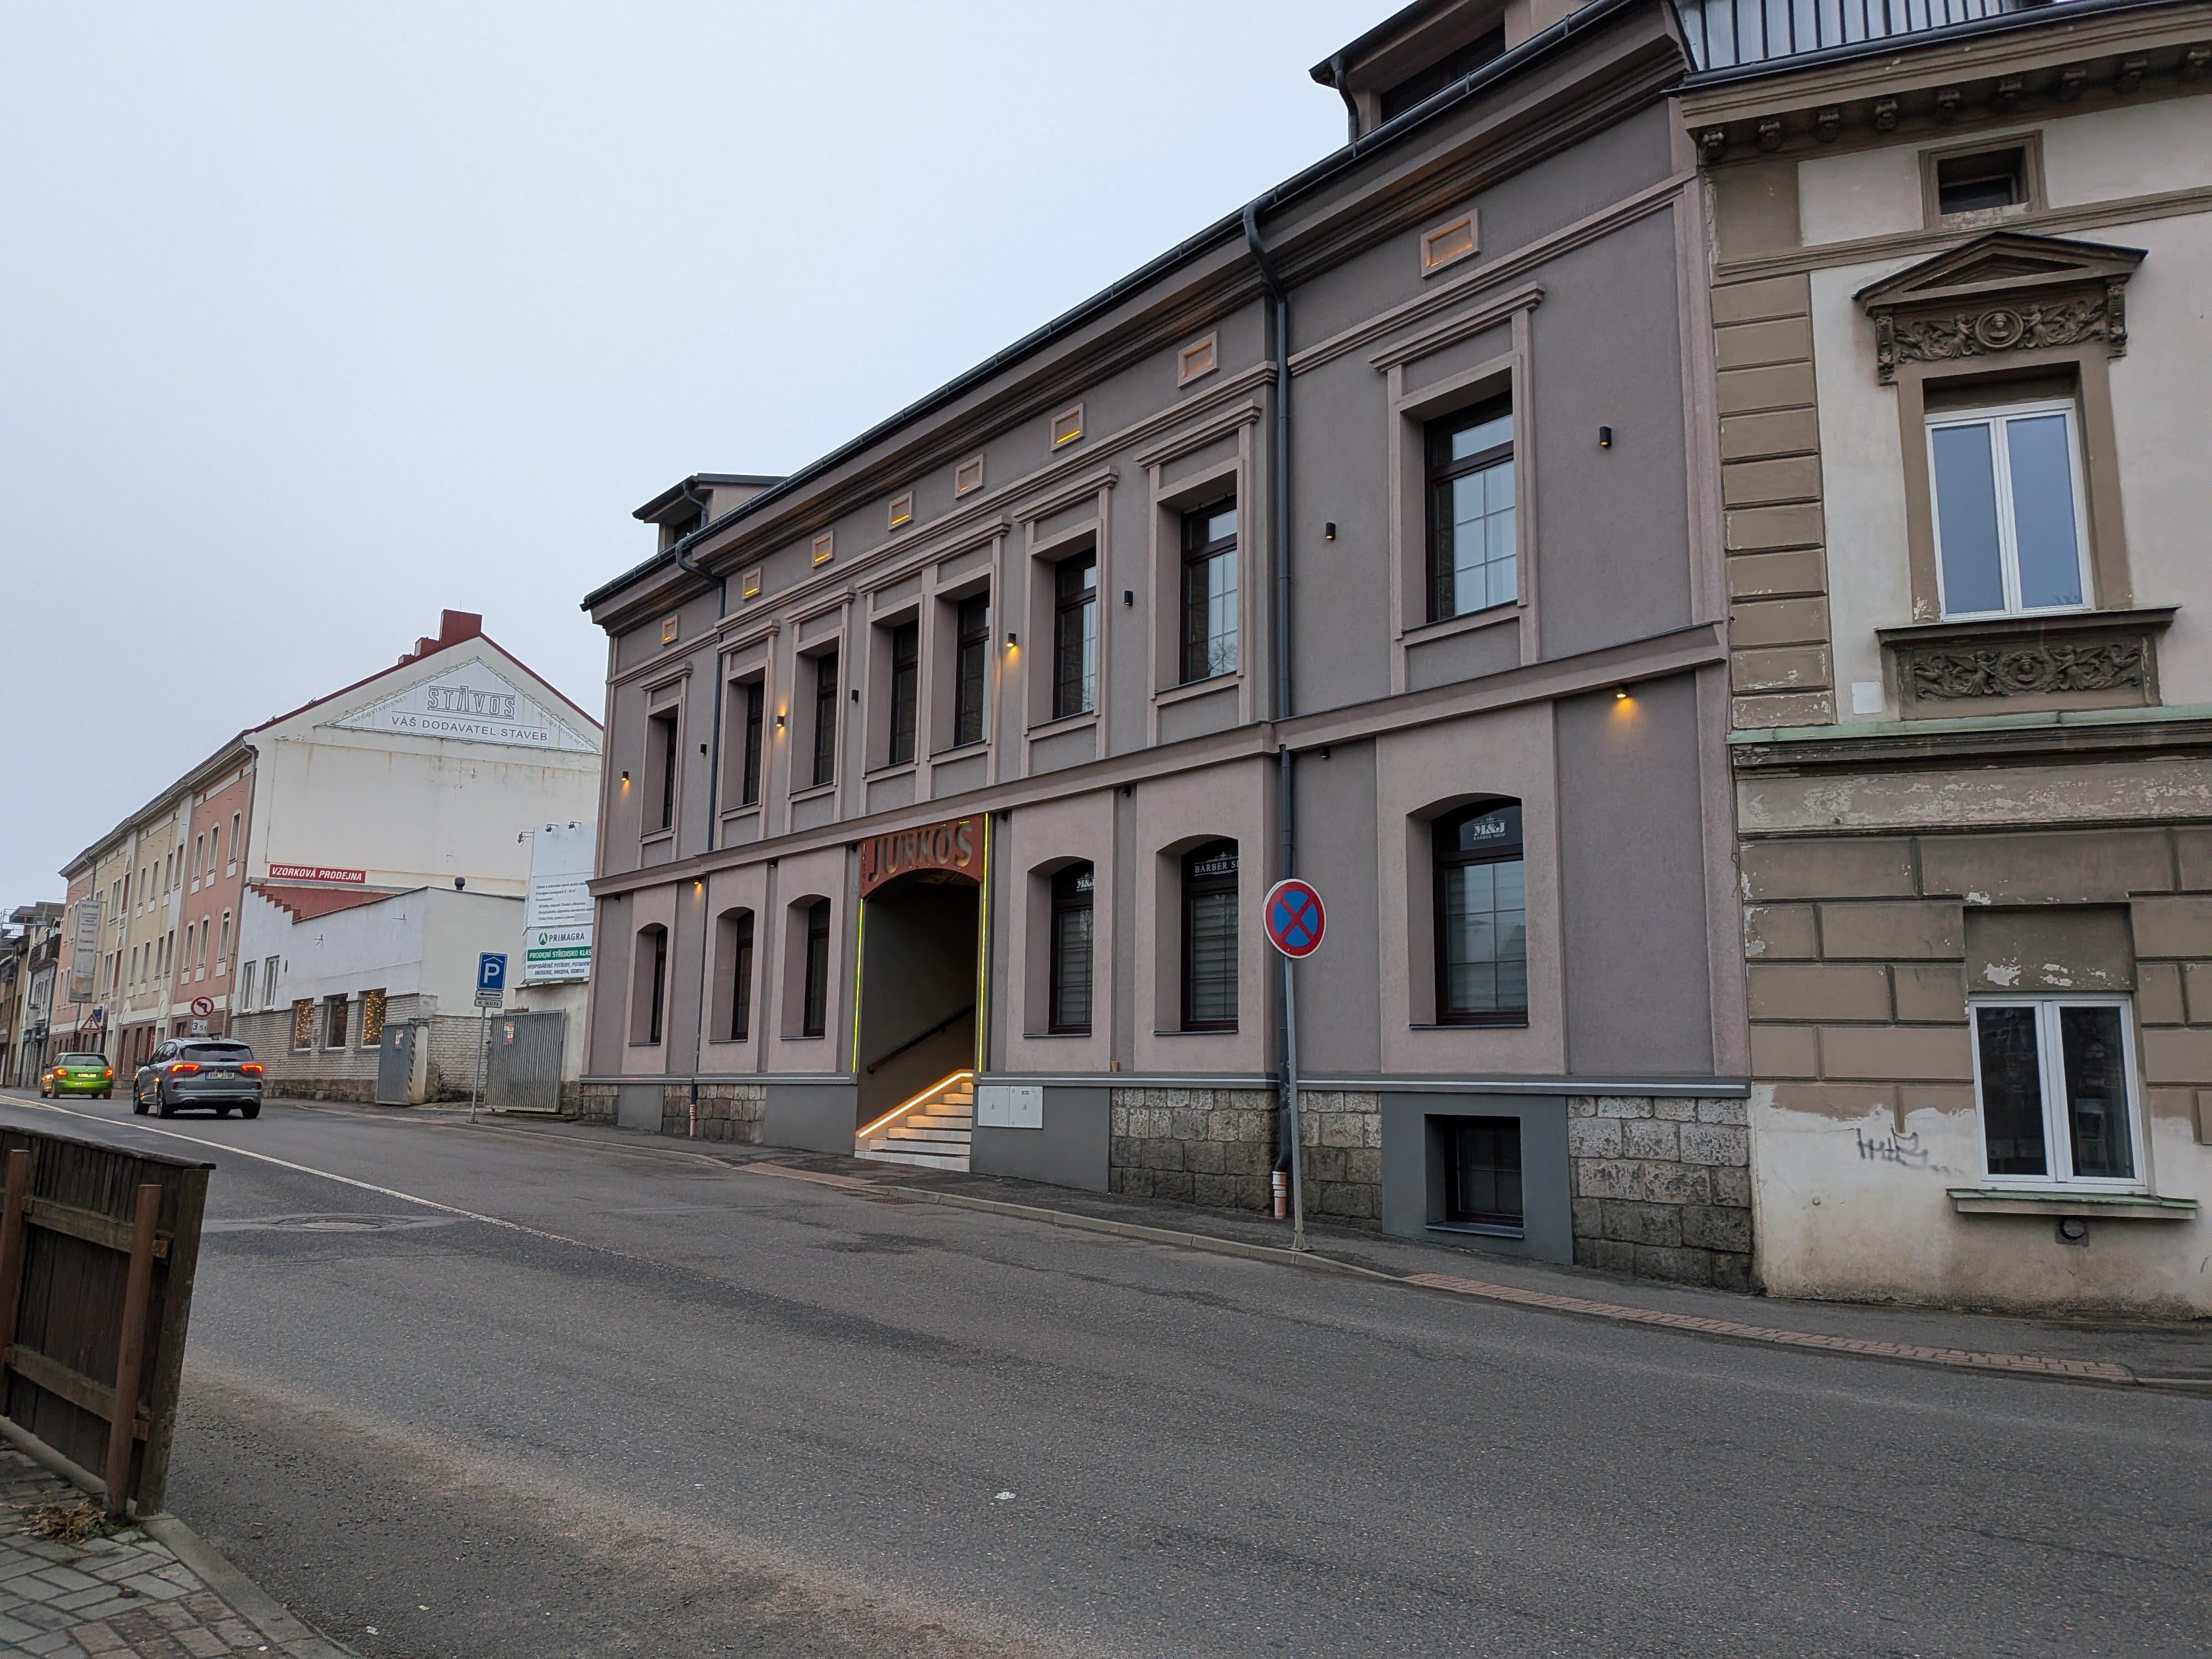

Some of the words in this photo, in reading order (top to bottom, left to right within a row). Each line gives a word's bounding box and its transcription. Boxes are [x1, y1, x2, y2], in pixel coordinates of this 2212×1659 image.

[427, 686, 515, 719] STAVOS
[392, 716, 417, 727] VÁŠ
[422, 719, 496, 735] DODAVATEL
[500, 728, 548, 741] STAVEB
[1473, 822, 1505, 836] M&J
[867, 823, 972, 883] JURKOS
[272, 867, 316, 878] VZORKOVÁ
[319, 870, 362, 881] PRODEJNA
[1194, 862, 1228, 873] BARBER
[549, 932, 585, 942] PRIMAGRA
[529, 950, 552, 959] PRODEJNÍ
[552, 948, 578, 958] STŘEDISKO
[484, 963, 500, 983] P
